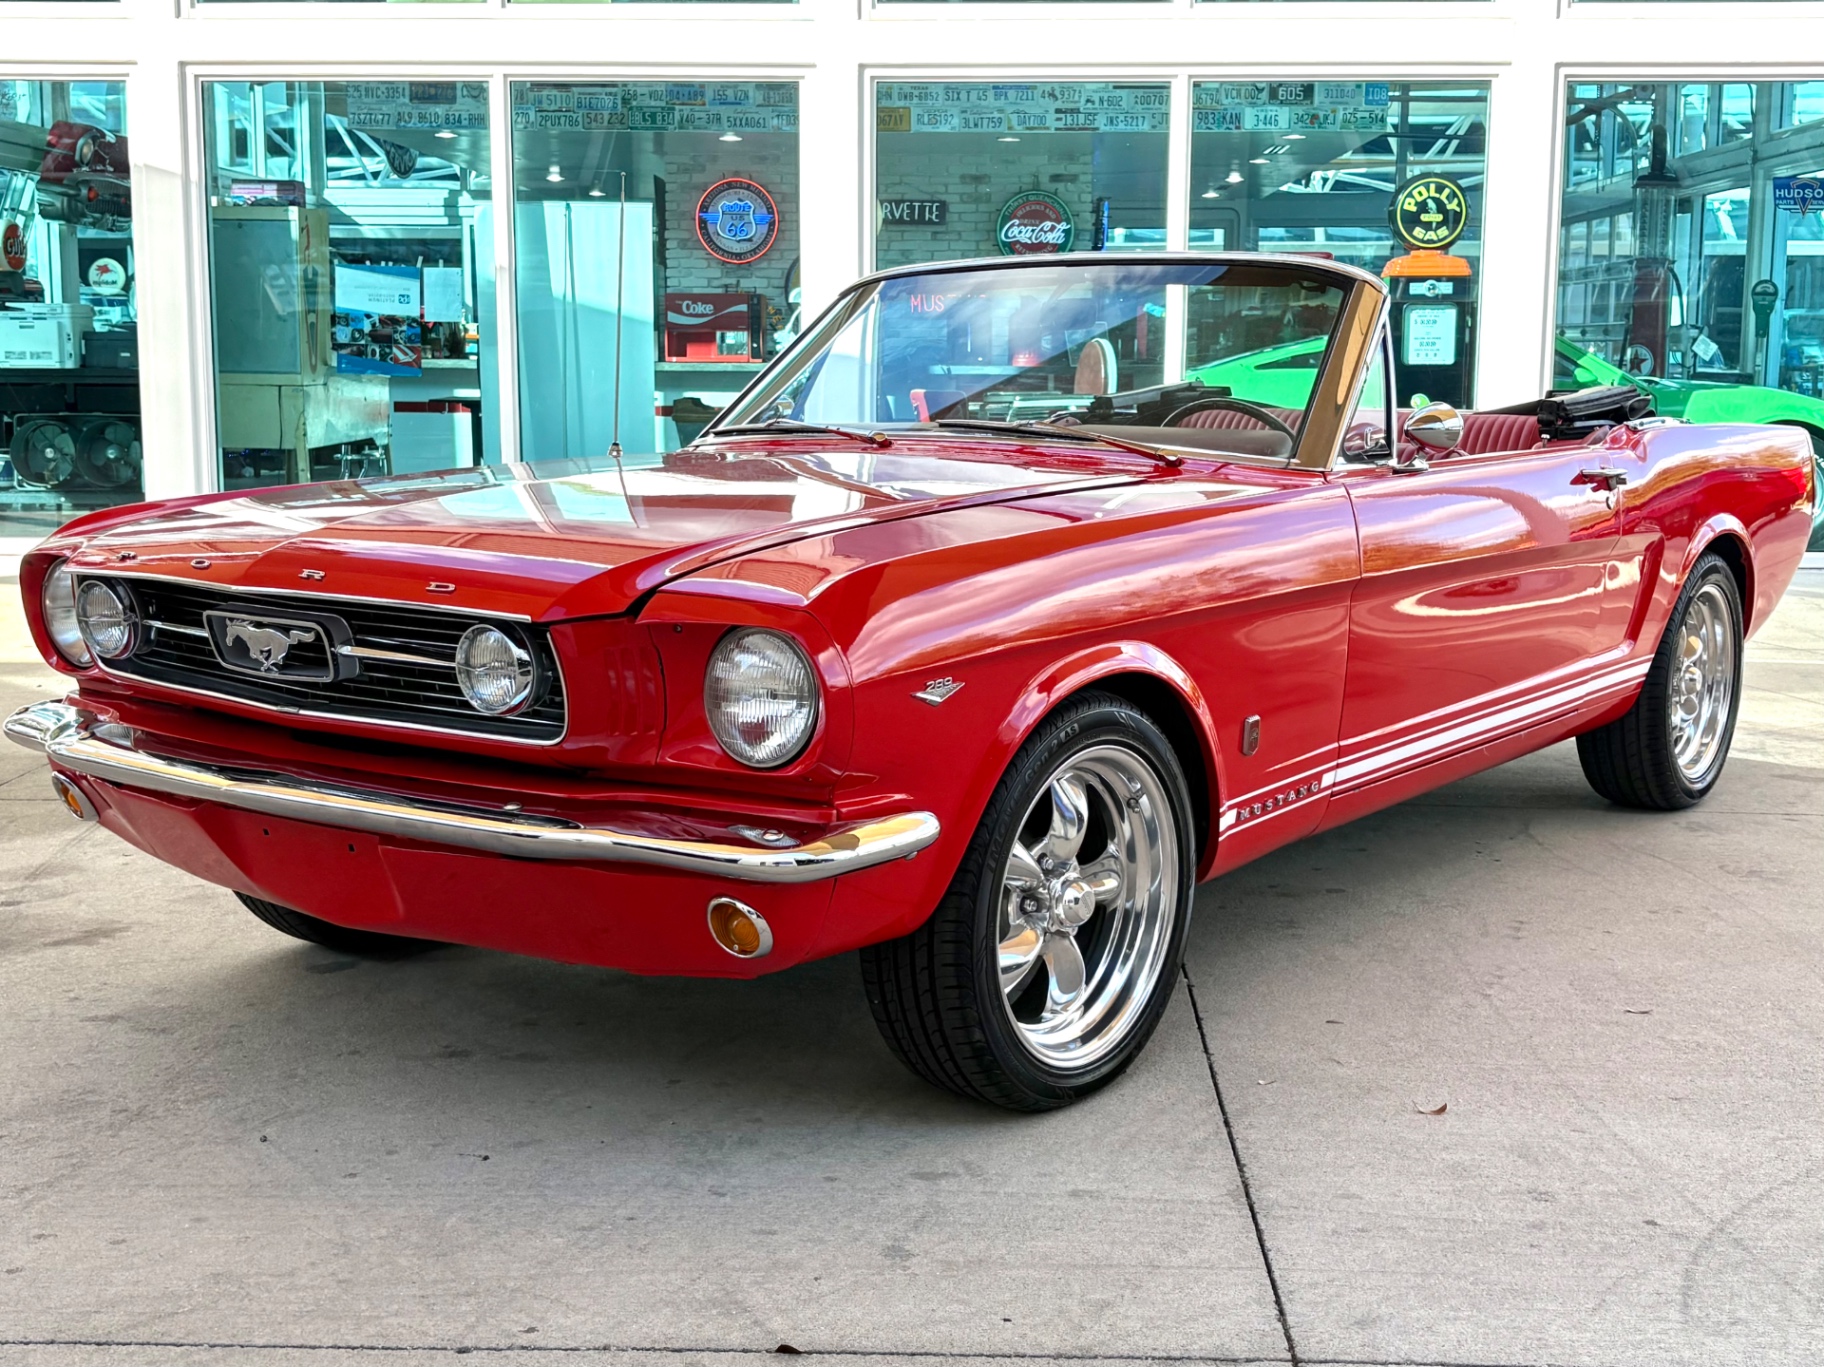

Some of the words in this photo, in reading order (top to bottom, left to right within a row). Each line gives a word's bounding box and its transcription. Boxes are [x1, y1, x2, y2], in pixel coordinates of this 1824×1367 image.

[944, 90, 961, 102] SIX
[966, 90, 971, 102] T
[1278, 87, 1304, 101] 605
[538, 114, 580, 128] 2PUX786
[586, 112, 605, 125] 543
[607, 113, 627, 126] 232
[726, 116, 767, 129] 5XXA061
[1197, 111, 1216, 126] 983
[1402, 182, 1461, 212] POLLY
[723, 202, 752, 212] ROUTE
[726, 221, 748, 238] 66
[1412, 225, 1450, 241] GAS
[701, 230, 737, 260] CALIFORNIA
[682, 300, 715, 315] Coke
[925, 676, 953, 693] 289
[1239, 780, 1319, 821] MUSTANG
